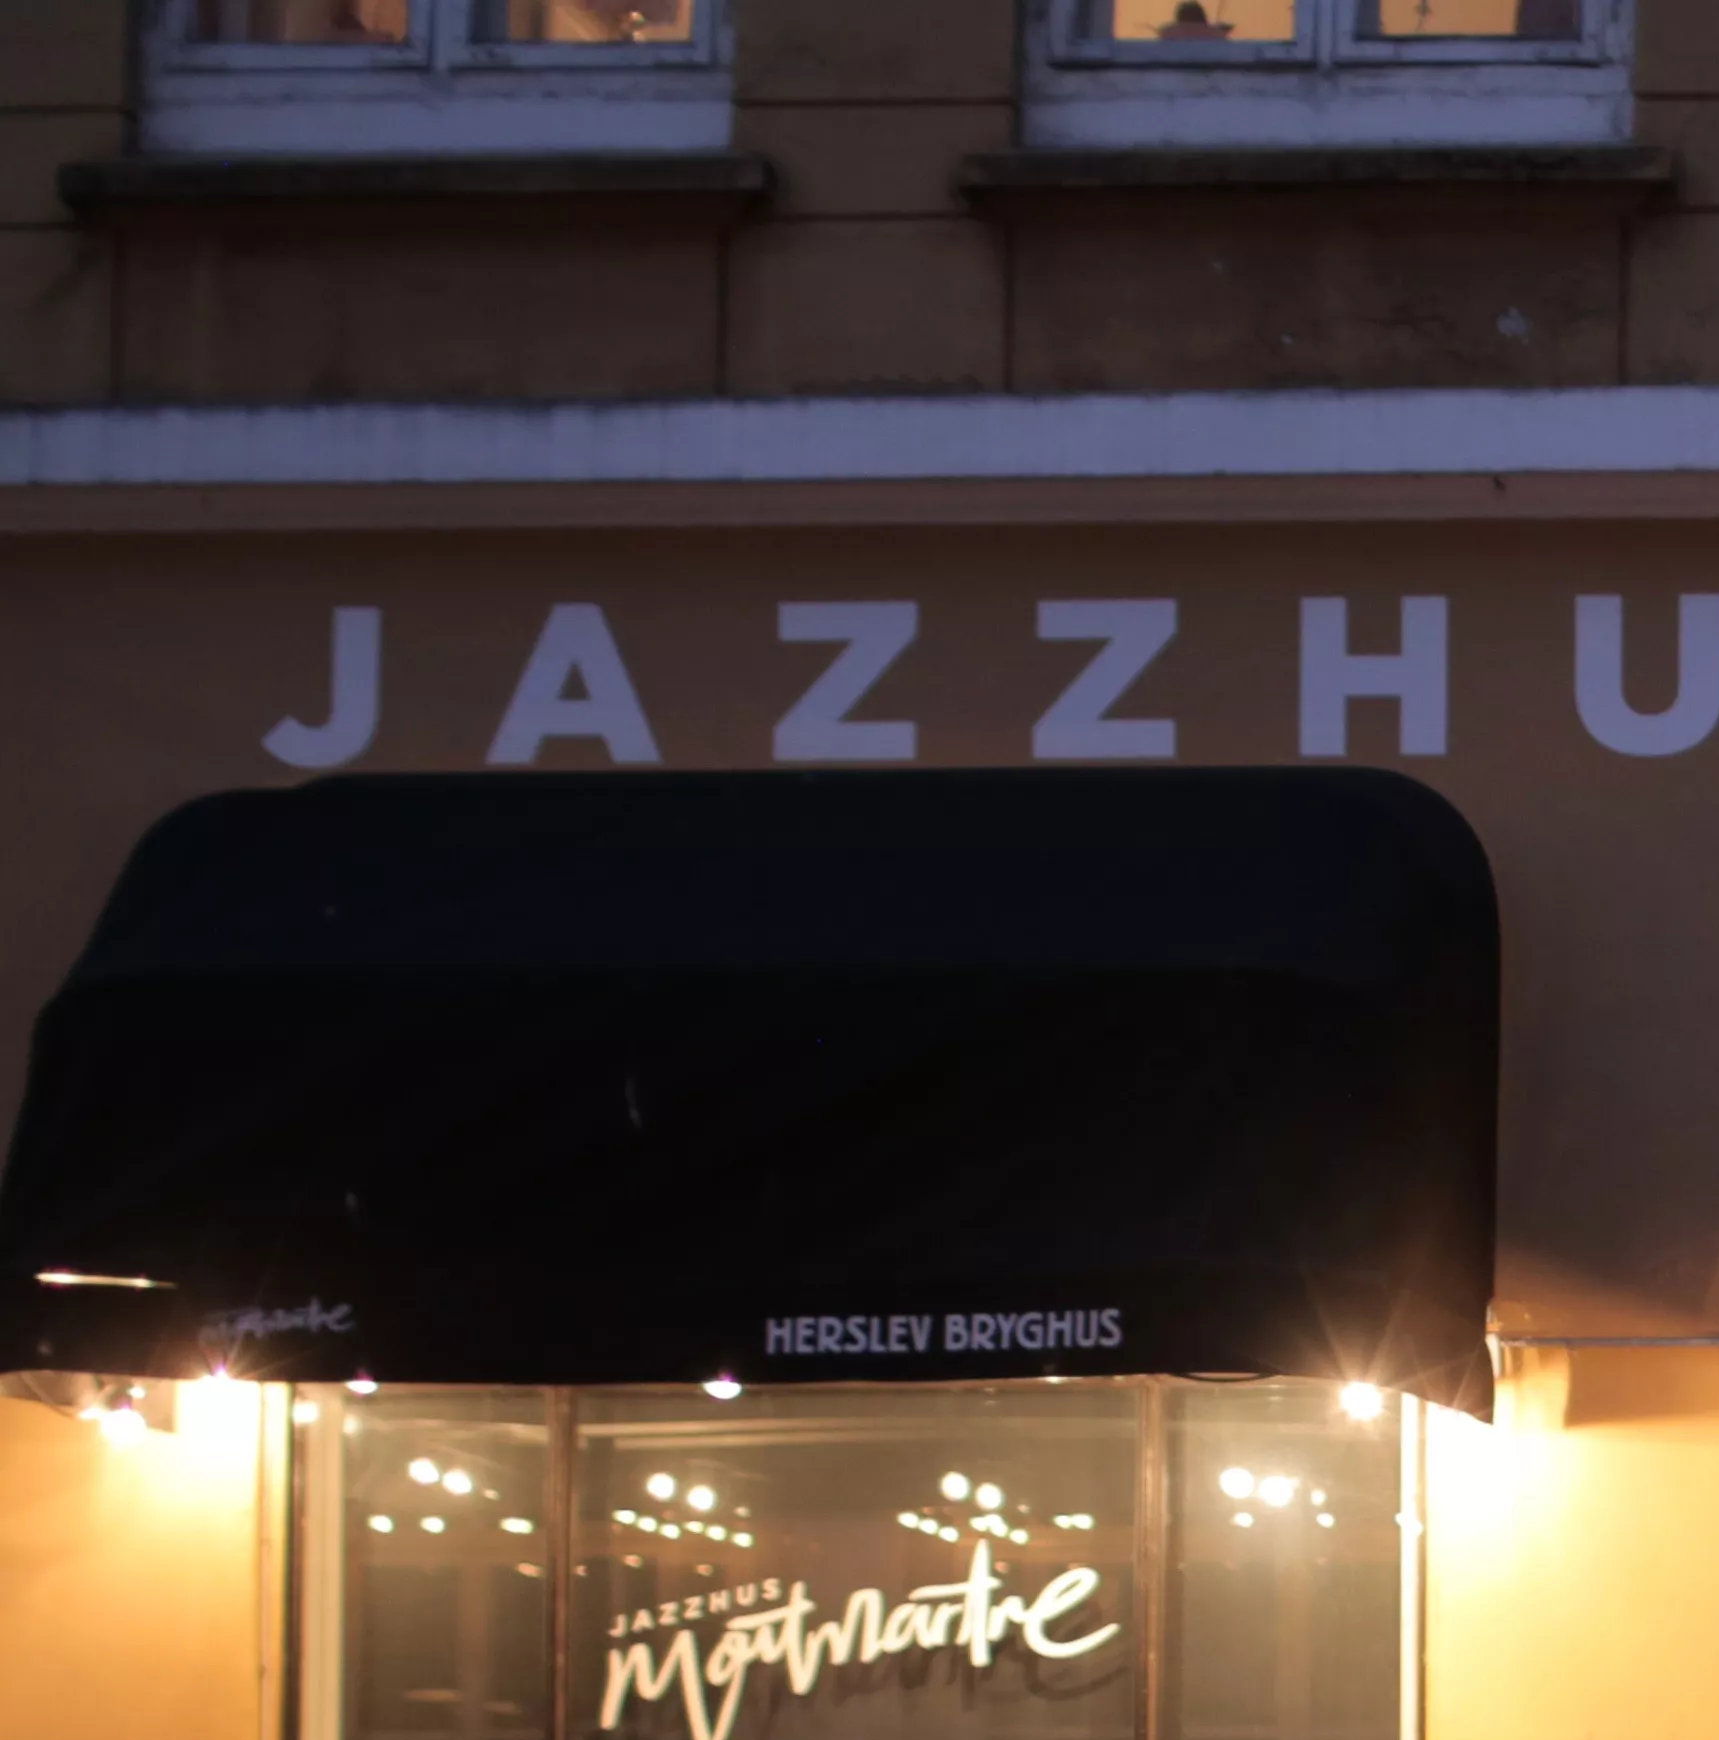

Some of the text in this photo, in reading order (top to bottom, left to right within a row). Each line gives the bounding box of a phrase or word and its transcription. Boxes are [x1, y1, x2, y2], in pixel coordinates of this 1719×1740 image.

[765, 1307, 1122, 1356] HERSLEV BRYGHUS
[609, 1576, 782, 1638] JAZZHUS
